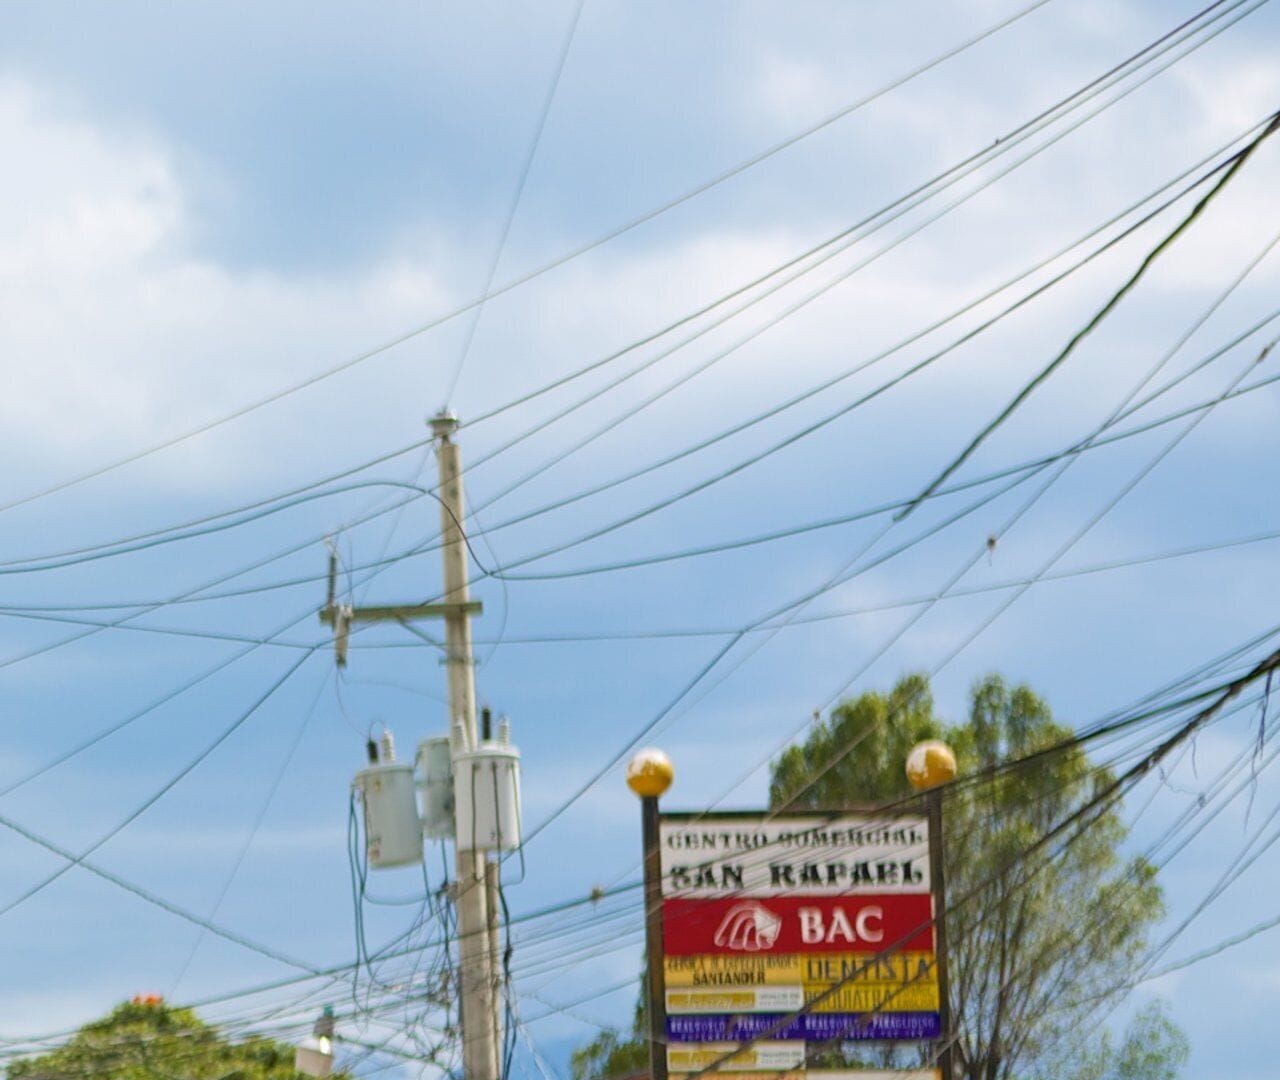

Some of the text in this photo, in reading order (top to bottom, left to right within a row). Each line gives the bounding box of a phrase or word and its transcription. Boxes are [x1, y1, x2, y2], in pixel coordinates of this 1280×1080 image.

[667, 828, 922, 850] CENTRO COMERCIAL
[669, 859, 923, 889] SAN RAFAEL
[798, 905, 884, 944] BAC
[692, 971, 766, 986] SANTANDER
[806, 957, 931, 980] DENTISTA
